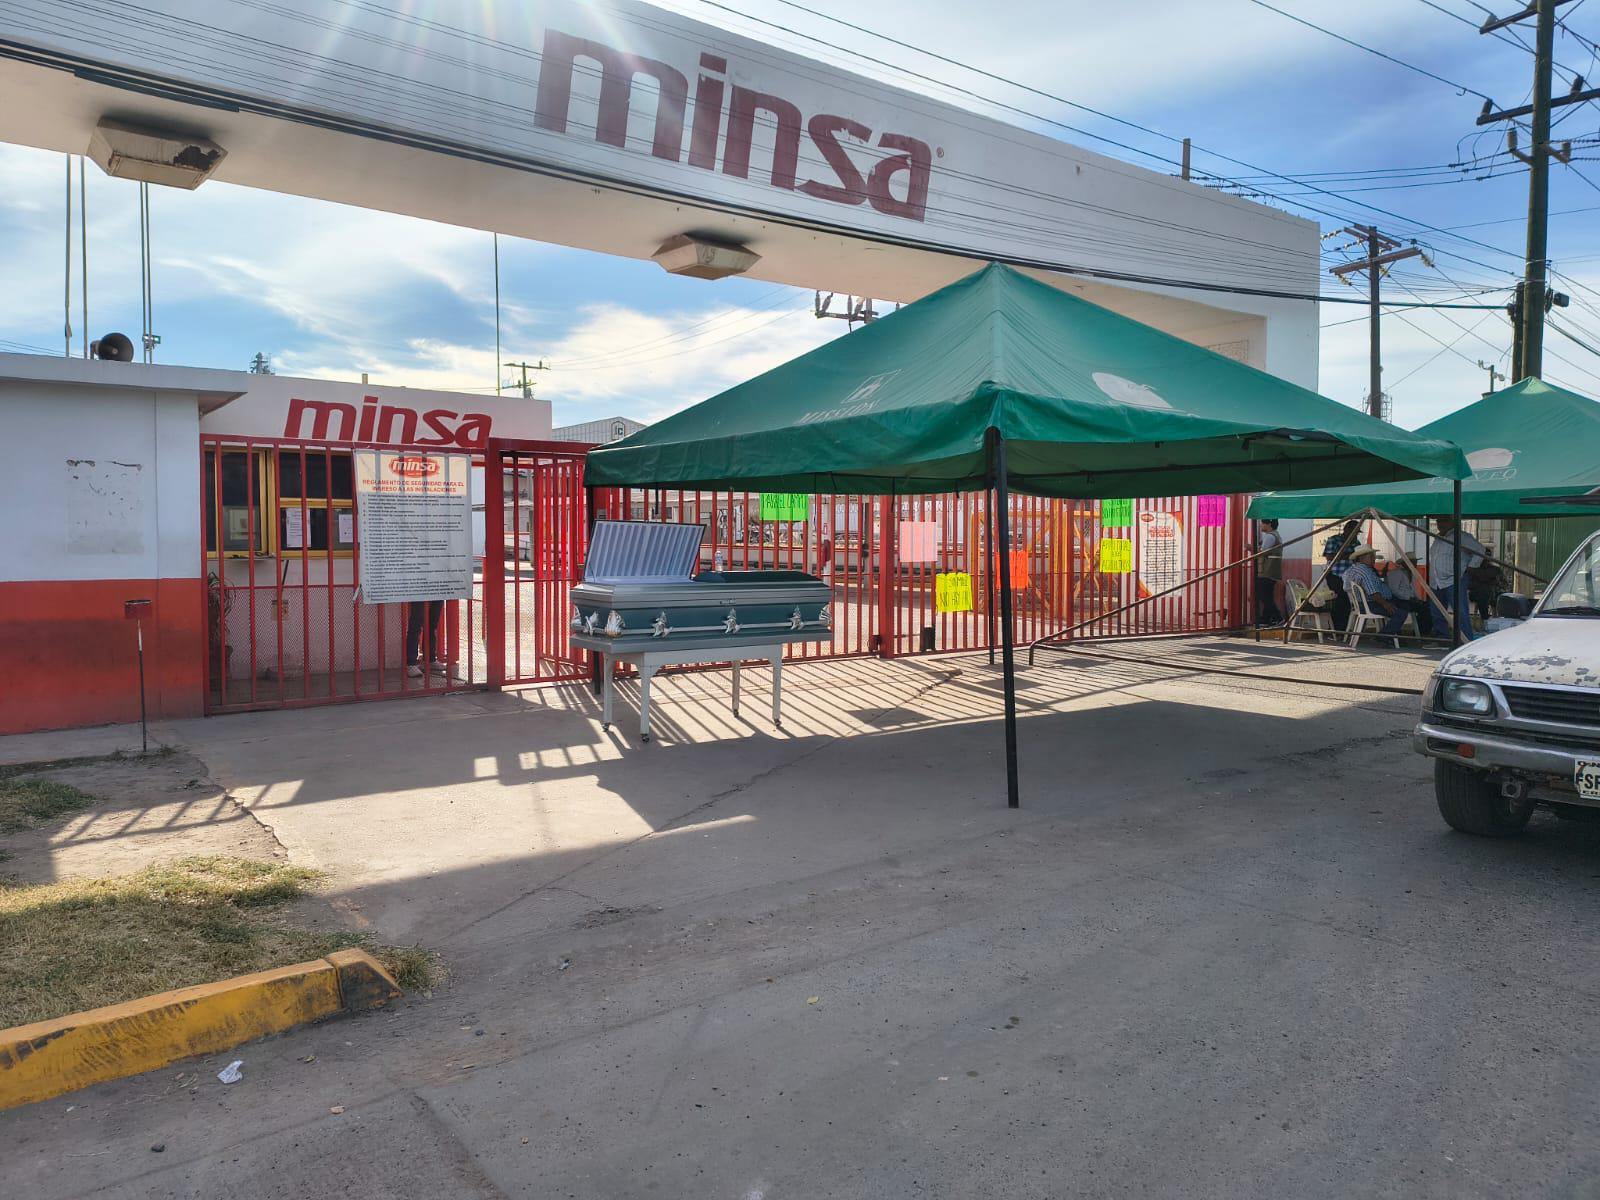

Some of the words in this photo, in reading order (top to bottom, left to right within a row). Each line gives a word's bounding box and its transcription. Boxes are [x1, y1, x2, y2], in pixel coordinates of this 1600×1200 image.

[534, 28, 932, 223] minsa
[284, 396, 492, 448] minsa
[392, 458, 436, 471] minsa
